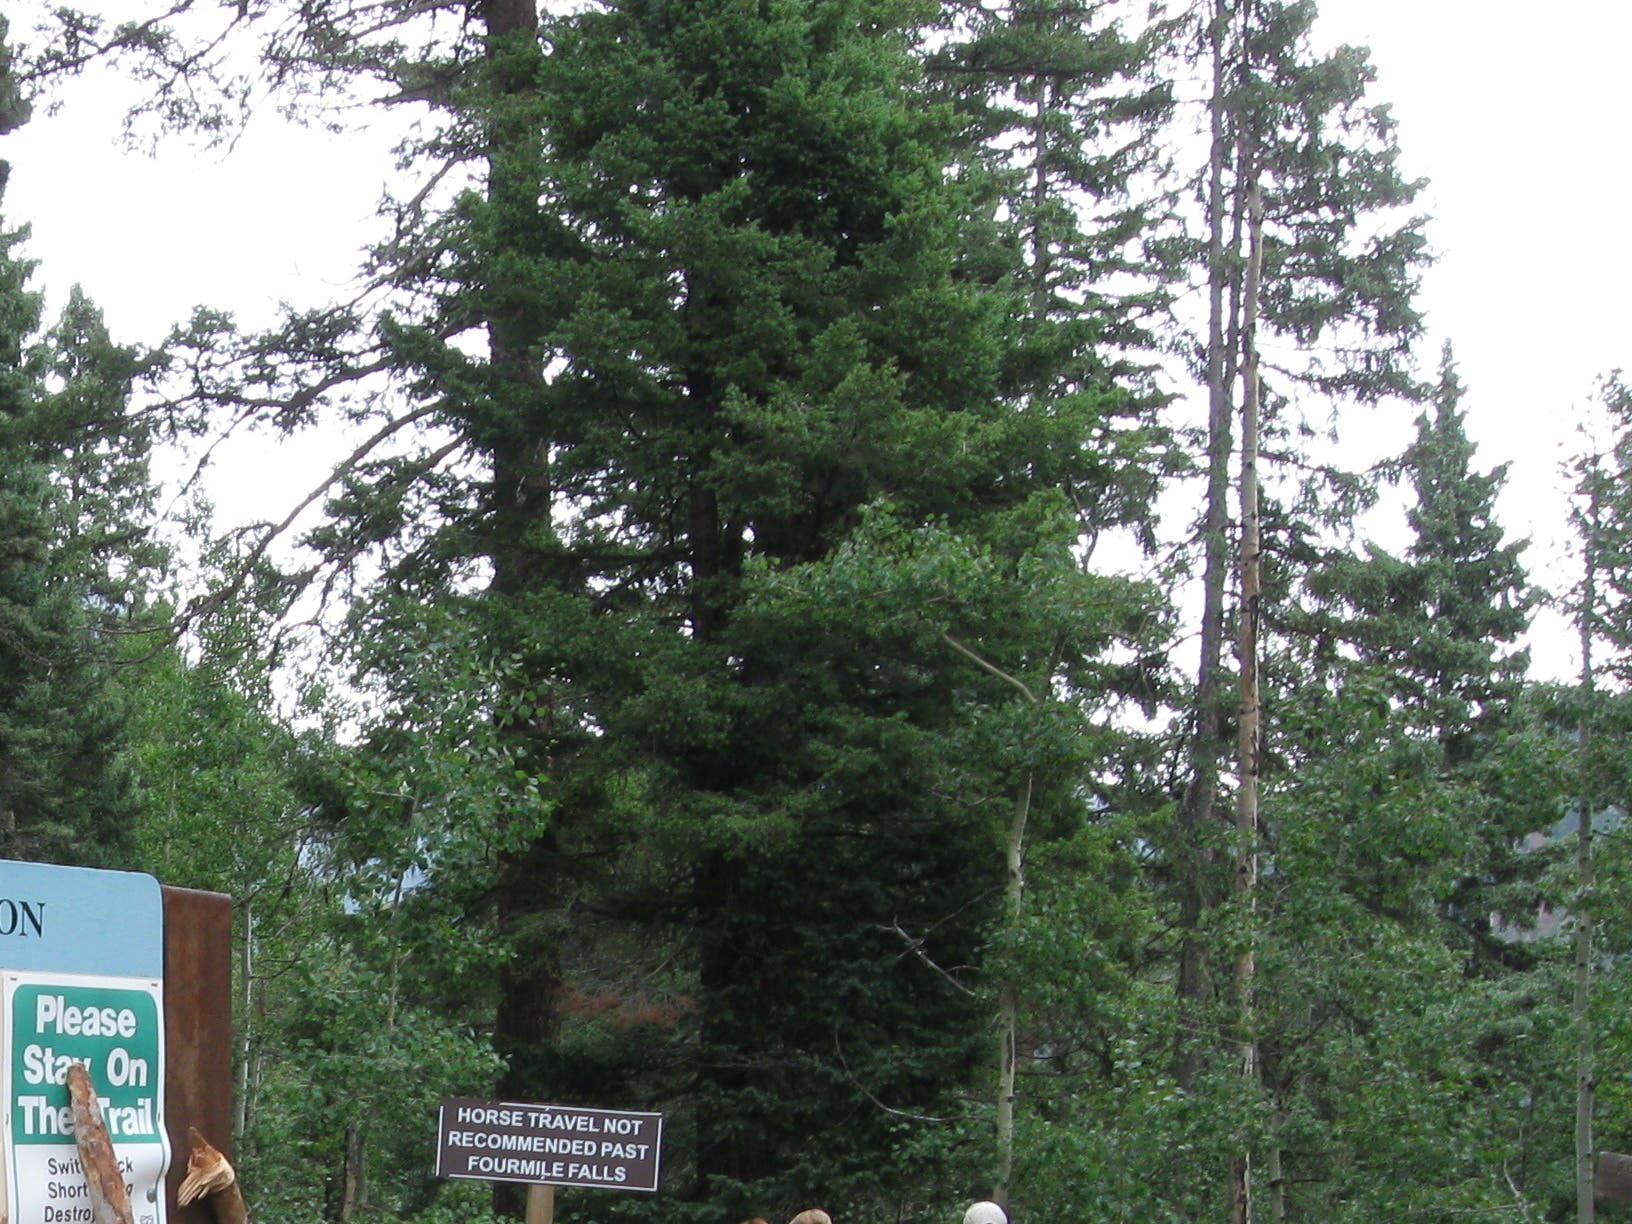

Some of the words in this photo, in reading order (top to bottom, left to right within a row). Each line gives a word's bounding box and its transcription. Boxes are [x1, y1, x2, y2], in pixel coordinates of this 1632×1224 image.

[36, 994, 137, 1038] Please
[107, 1047, 148, 1087] On
[17, 1095, 75, 1136] The
[97, 1097, 155, 1136] Trail
[458, 1107, 523, 1127] HORSE
[527, 1112, 601, 1133] TRAVEL
[603, 1118, 643, 1136] NOT
[448, 1131, 597, 1157] RECOMMENDED
[601, 1142, 650, 1160] PAST
[47, 1157, 134, 1175] Switck
[467, 1155, 565, 1178] FOURMILE
[568, 1163, 628, 1182] FALLS
[44, 1205, 96, 1224] Destro
